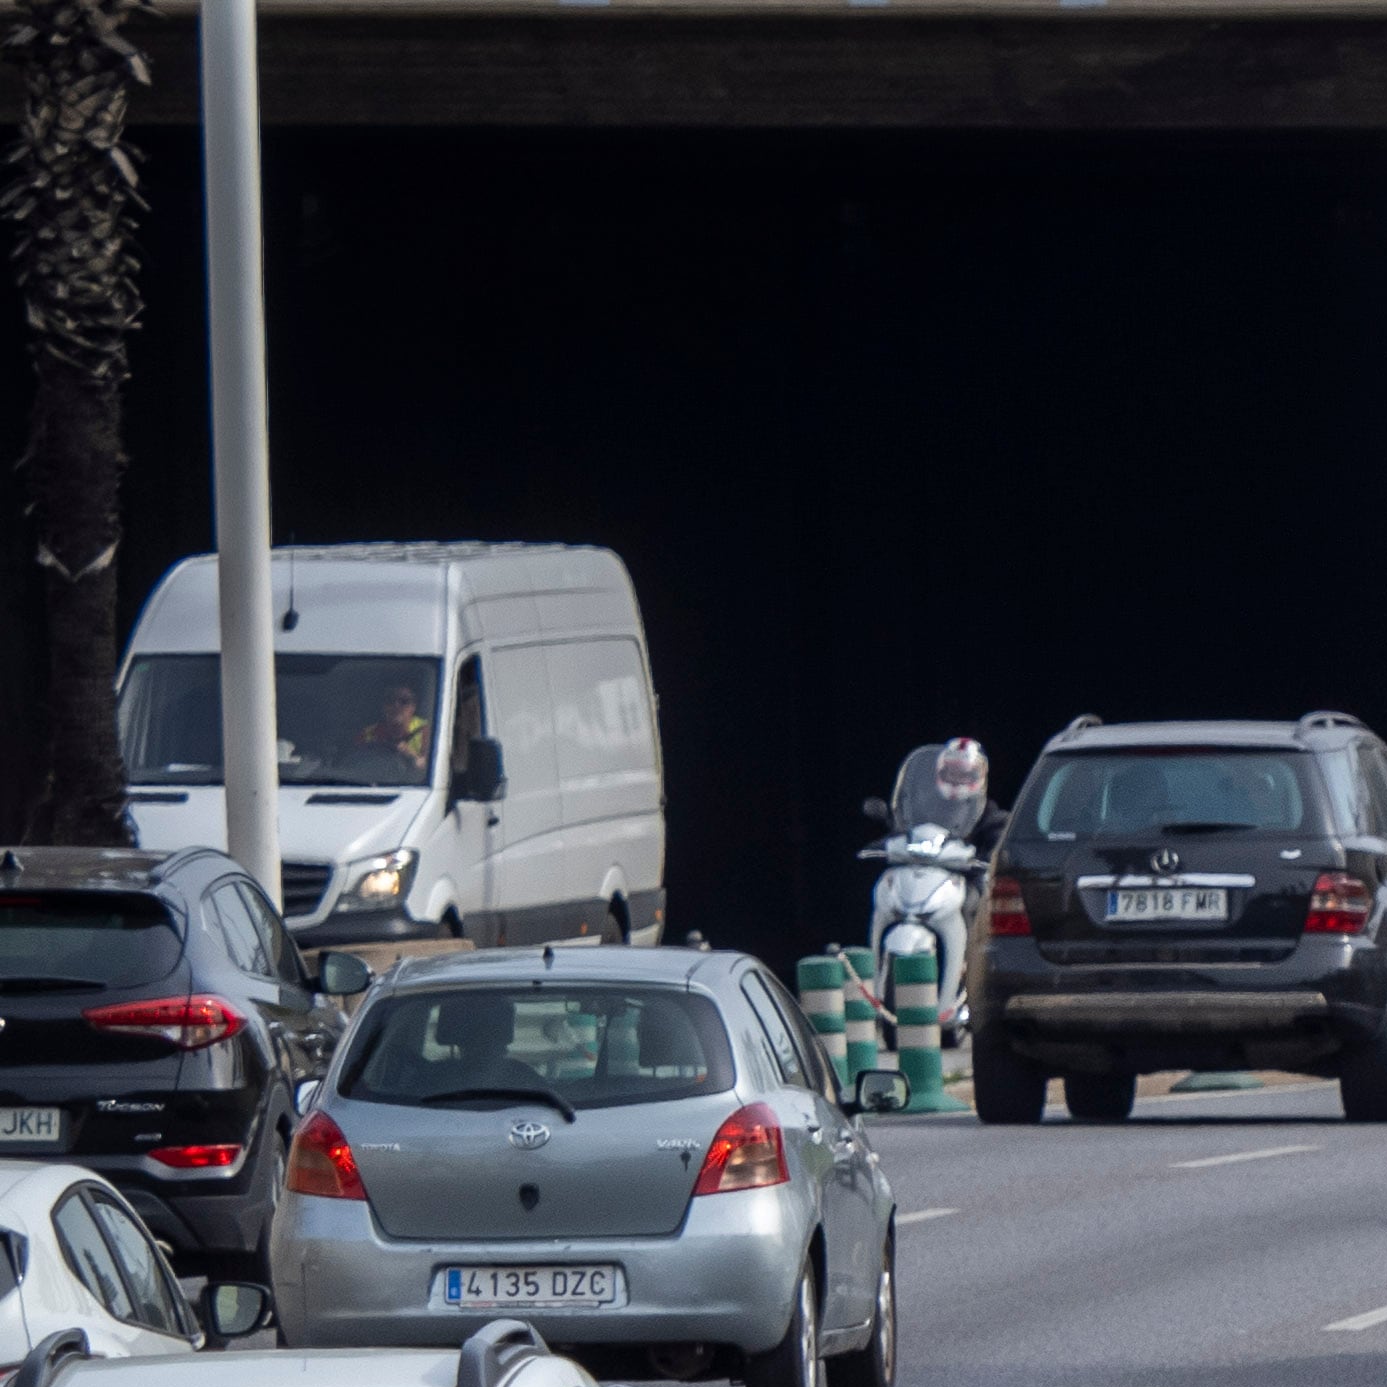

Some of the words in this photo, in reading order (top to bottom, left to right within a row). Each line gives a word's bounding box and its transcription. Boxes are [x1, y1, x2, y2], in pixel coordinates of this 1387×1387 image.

[3, 1111, 53, 1135] JKH
[467, 1271, 540, 1297] 4135
[552, 1270, 606, 1297] DZC
